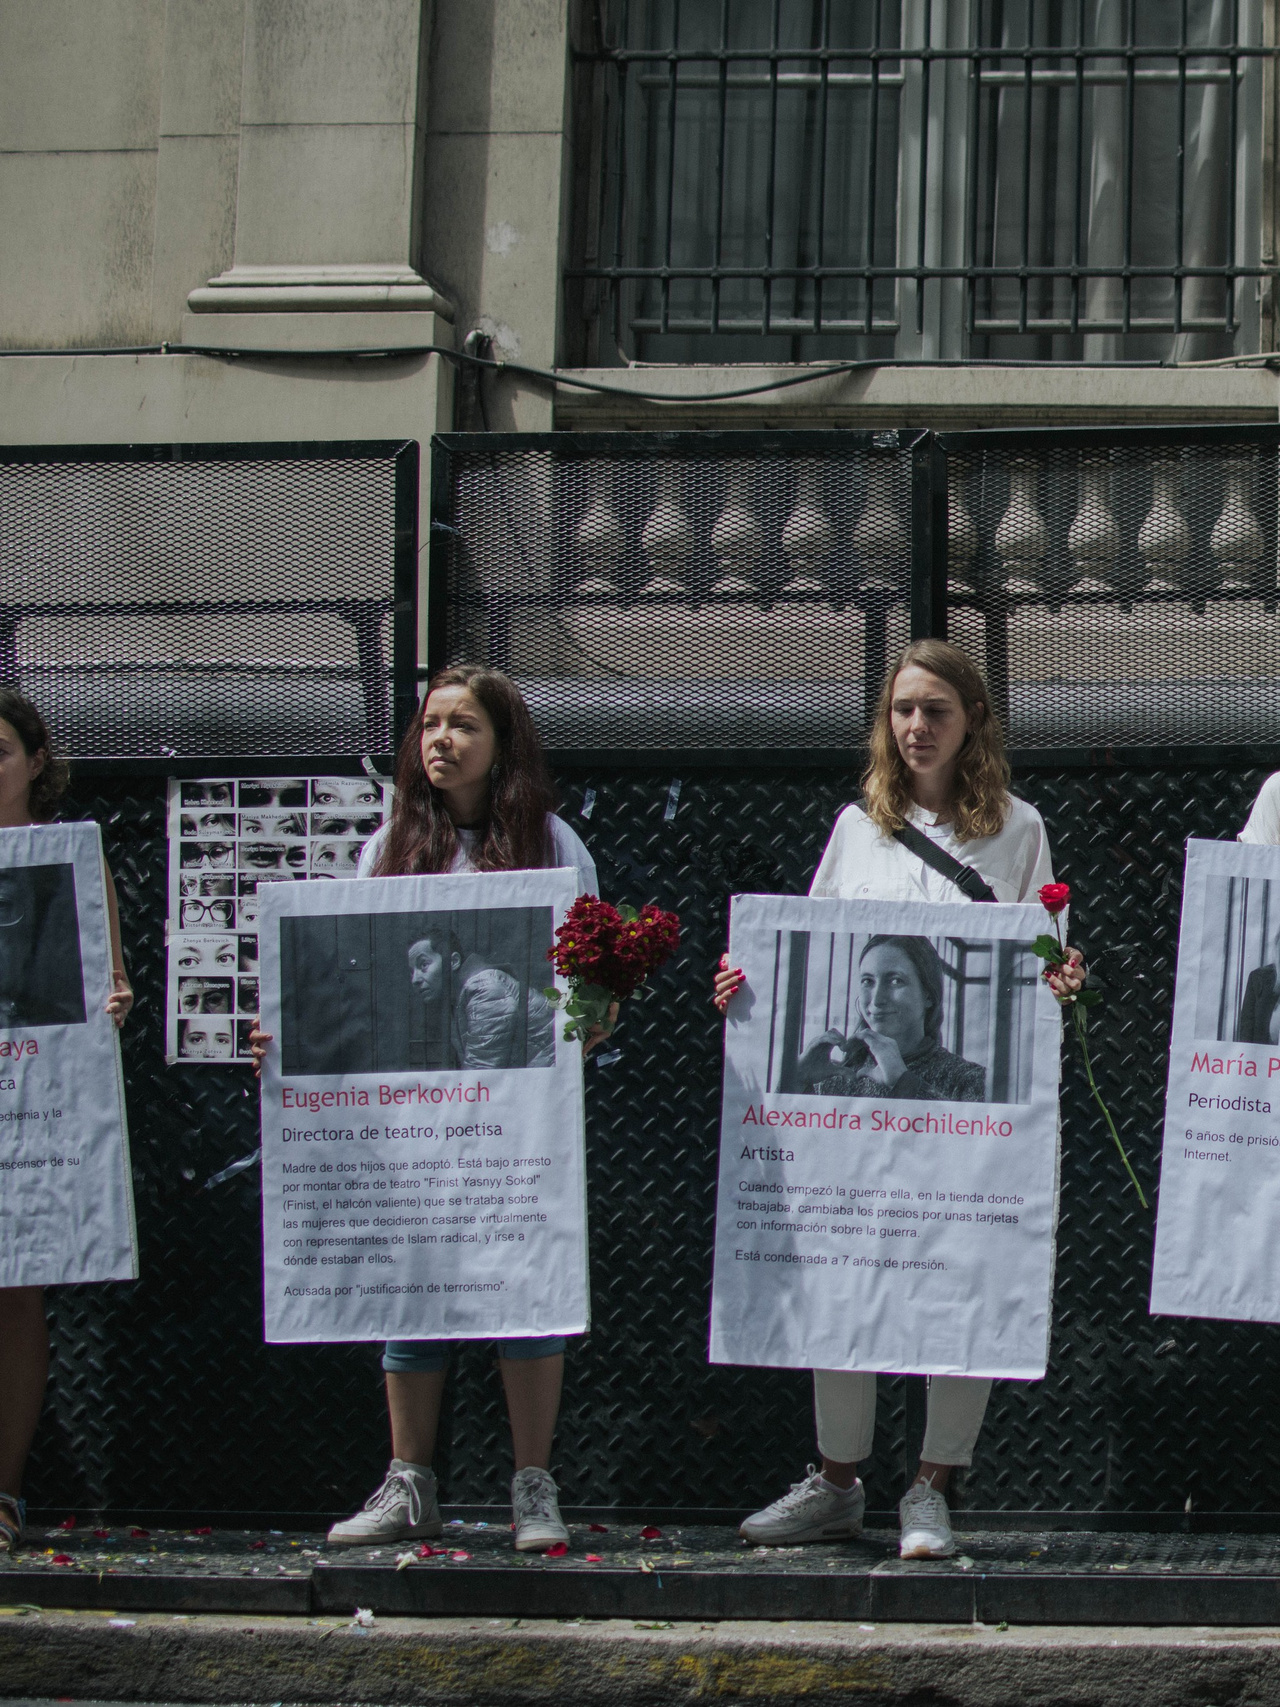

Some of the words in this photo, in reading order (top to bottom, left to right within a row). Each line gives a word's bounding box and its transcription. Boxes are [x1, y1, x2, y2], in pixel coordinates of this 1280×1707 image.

[1191, 1052, 1257, 1077] María
[282, 1086, 369, 1112] Eugenia
[379, 1081, 489, 1105] Berkovich
[1189, 1093, 1271, 1113] Periodista
[43, 1110, 50, 1122] y
[52, 1108, 62, 1119] la
[742, 1104, 861, 1130] Alexandra
[871, 1110, 1012, 1137] Skochilenko
[283, 1128, 354, 1142] Directora
[360, 1125, 379, 1140] de
[385, 1125, 438, 1140] teatro,
[446, 1122, 503, 1141] poetisa
[1185, 1129, 1192, 1140] 6
[1196, 1131, 1225, 1142] años
[1229, 1133, 1243, 1143] de
[50, 1157, 64, 1167] de
[67, 1157, 80, 1166] su
[740, 1145, 794, 1161] Artista
[1184, 1148, 1232, 1162] Internet.
[283, 1163, 316, 1173] Madre
[320, 1162, 333, 1172] de
[336, 1162, 357, 1172] dos
[361, 1161, 385, 1174] hijos
[389, 1162, 408, 1172] que
[411, 1157, 453, 1171] adoptó.
[458, 1156, 482, 1168] Está
[486, 1157, 509, 1170] bajo
[513, 1157, 551, 1167] arresto
[283, 1184, 300, 1194] por
[303, 1181, 341, 1191] montar
[345, 1180, 369, 1190] obra
[373, 1179, 386, 1189] de
[390, 1179, 420, 1189] teatro
[424, 1177, 458, 1187] "Finist
[462, 1177, 502, 1188] Yasnyy
[506, 1174, 540, 1186] Sokol"
[739, 1181, 783, 1193] Cuando
[787, 1186, 832, 1196] empezó
[837, 1186, 845, 1196] la
[850, 1189, 886, 1199] guerra
[891, 1189, 914, 1201] ella,
[918, 1192, 932, 1200] en
[936, 1191, 945, 1201] la
[949, 1192, 983, 1203] tienda
[988, 1193, 1024, 1205] donde
[283, 1200, 318, 1212] (Finist,
[322, 1199, 332, 1209] el
[336, 1198, 372, 1209] halcón
[375, 1197, 421, 1209] valiente)
[424, 1199, 445, 1208] que
[449, 1198, 462, 1206] se
[465, 1195, 504, 1205] trataba
[508, 1194, 538, 1204] sobre
[283, 1219, 298, 1229] las
[302, 1218, 345, 1230] mujeres
[349, 1219, 369, 1229] que
[373, 1216, 428, 1226] decidieron
[432, 1216, 476, 1224] casarse
[480, 1212, 547, 1223] virtualmente
[737, 1200, 794, 1215] trabajaba,
[798, 1204, 853, 1215] cambiaba
[858, 1206, 873, 1216] los
[878, 1208, 919, 1219] precios
[923, 1211, 941, 1221] por
[945, 1212, 972, 1221] unas
[976, 1212, 1019, 1225] tarjetas
[737, 1221, 756, 1229] con
[761, 1220, 826, 1232] información
[831, 1224, 862, 1235] sobre
[867, 1225, 876, 1235] la
[880, 1228, 920, 1239] guerra.
[283, 1239, 302, 1247] con
[306, 1236, 388, 1248] representantes
[391, 1235, 404, 1244] de
[408, 1234, 437, 1244] Islam
[441, 1232, 481, 1244] radical,
[485, 1234, 491, 1244] y
[495, 1231, 514, 1241] irse
[518, 1233, 524, 1241] a
[284, 1255, 317, 1265] dónde
[321, 1255, 364, 1265] estaban
[368, 1254, 396, 1263] ellos.
[736, 1250, 760, 1261] Está
[764, 1253, 827, 1264] condenada
[831, 1257, 838, 1265] a
[842, 1255, 849, 1265] 7
[853, 1256, 880, 1267] años
[884, 1257, 899, 1268] de
[902, 1260, 947, 1270] presión.
[284, 1286, 331, 1296] Acusada
[335, 1287, 353, 1297] por
[356, 1283, 423, 1297] "justificación
[427, 1283, 440, 1293] de
[444, 1281, 507, 1292] terrorismo".
